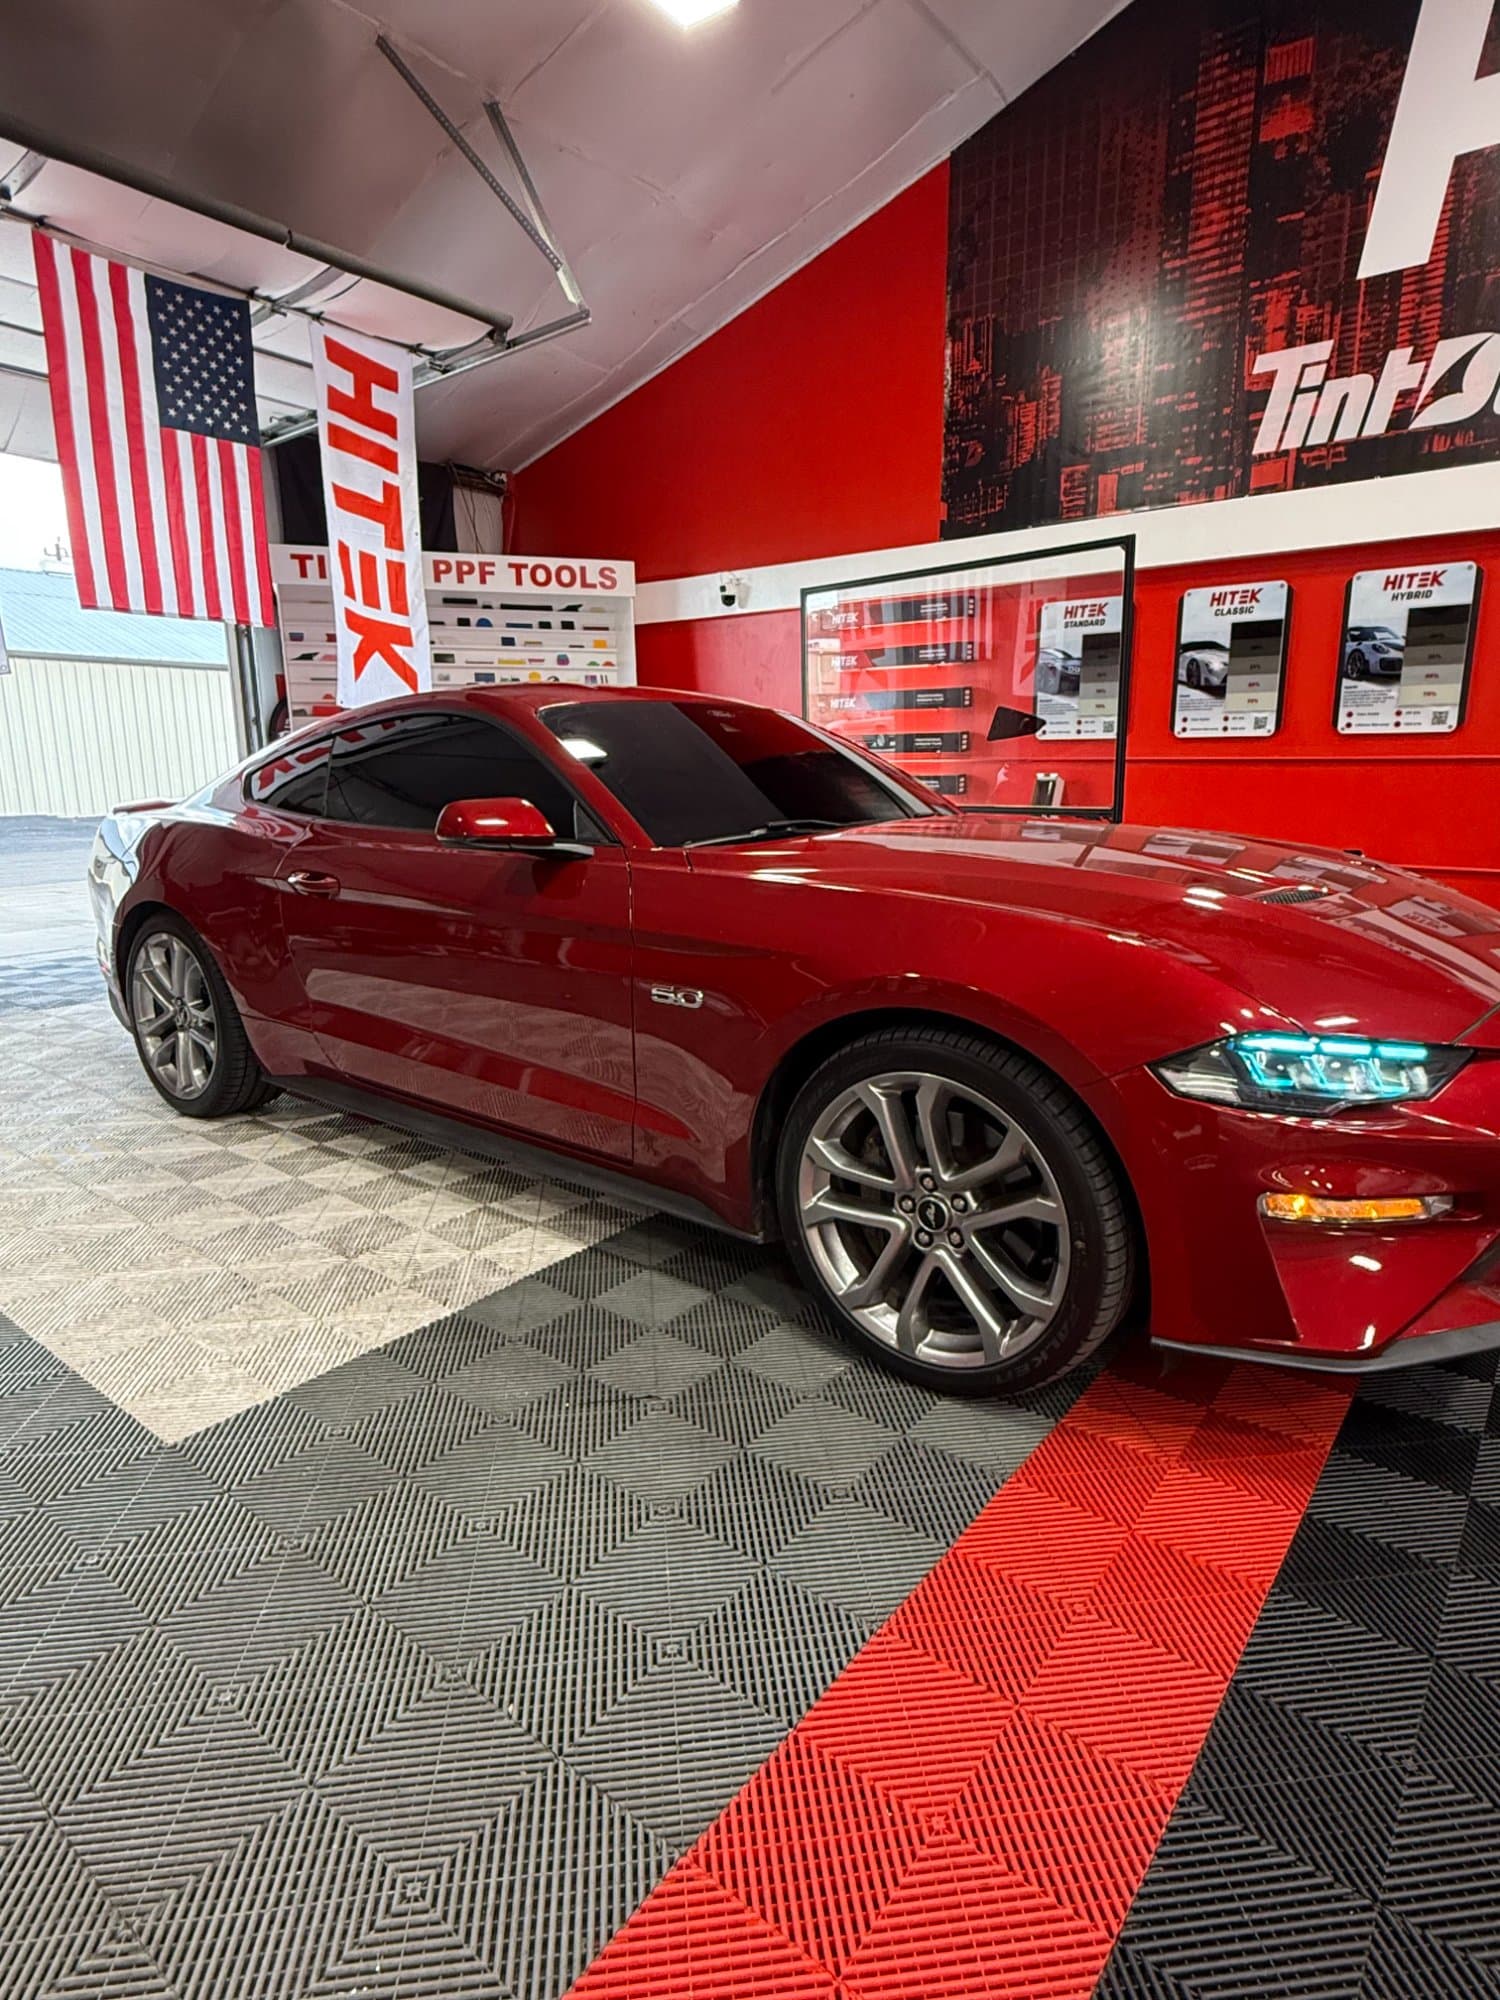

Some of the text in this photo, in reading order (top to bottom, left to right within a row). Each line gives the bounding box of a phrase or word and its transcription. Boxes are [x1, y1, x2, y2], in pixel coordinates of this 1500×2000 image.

[1252, 331, 1500, 455] TintD
[324, 335, 419, 694] HITEK
[432, 559, 496, 585] PPF
[507, 562, 618, 590] TOOLS
[1383, 569, 1448, 591] HITEK
[1209, 588, 1264, 608] HITEK
[1391, 589, 1433, 602] HYBRID
[1063, 602, 1109, 620] HITEK
[1214, 605, 1255, 617] CLASSIC
[1063, 618, 1107, 629] STANDARD
